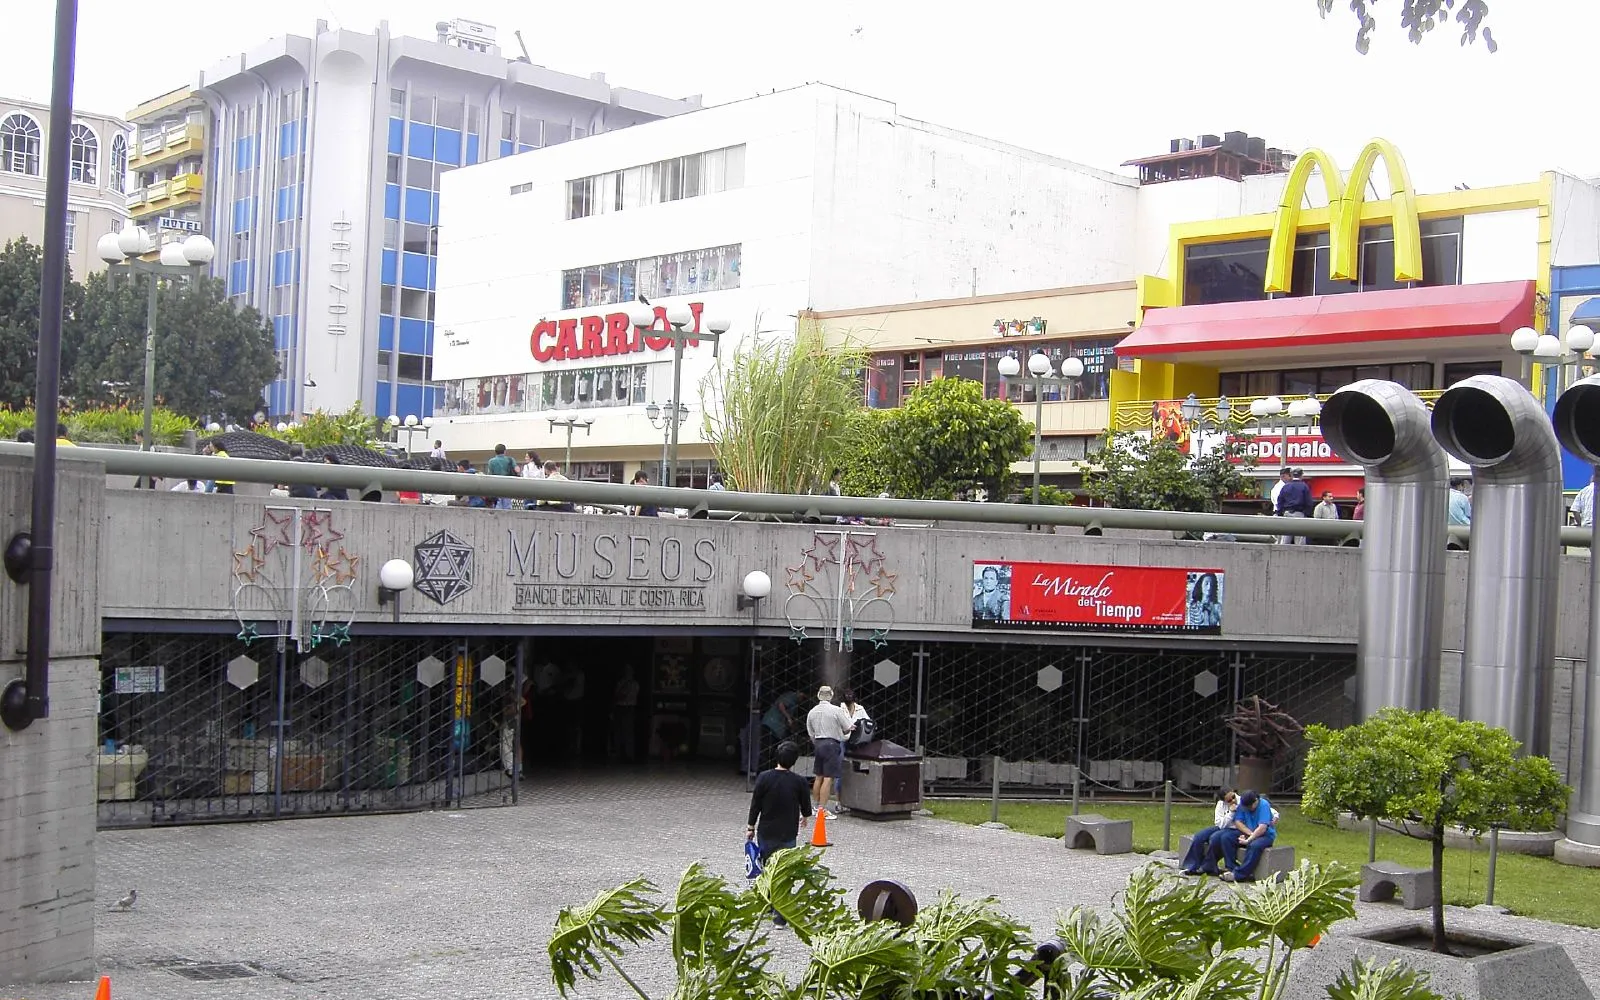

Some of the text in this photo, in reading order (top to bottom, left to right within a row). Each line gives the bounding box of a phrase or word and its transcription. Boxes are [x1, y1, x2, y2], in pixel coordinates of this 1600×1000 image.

[162, 218, 200, 231] HOTEL
[530, 302, 704, 363] CARRON
[506, 528, 717, 583] MUSEOS
[515, 585, 705, 608] BANCO CENTRAL DE COSTA RICA
[1032, 572, 1113, 598] La Mirada
[1078, 596, 1096, 607] del
[1095, 600, 1142, 622] Tiempo
